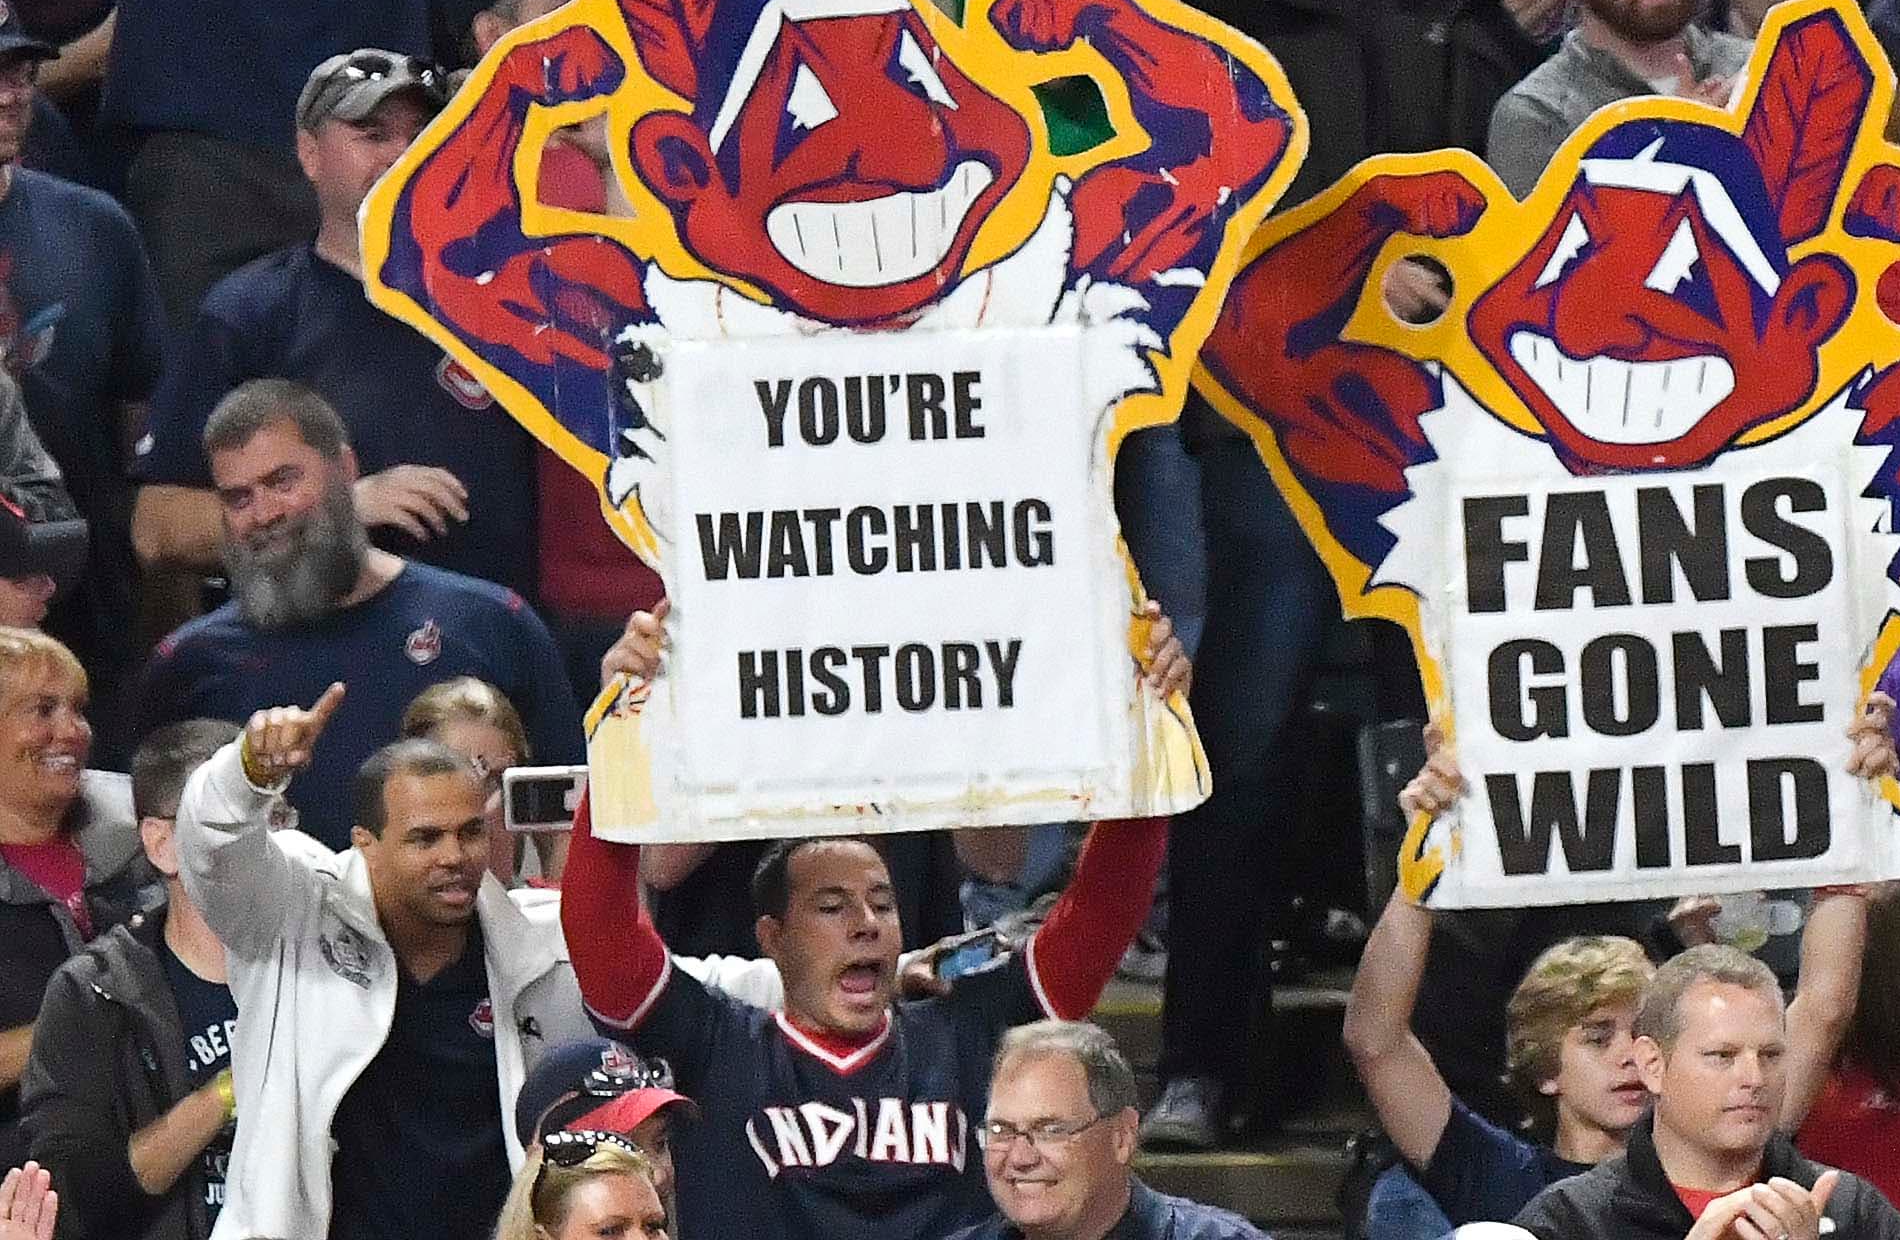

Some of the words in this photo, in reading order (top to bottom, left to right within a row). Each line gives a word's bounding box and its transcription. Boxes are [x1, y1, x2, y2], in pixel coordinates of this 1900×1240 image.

[754, 371, 986, 448] YOU'RE
[695, 498, 1055, 581] WATCHING
[1462, 476, 1834, 615] FANS
[737, 639, 1022, 719] HISTORY
[1487, 623, 1825, 743] GONE
[1484, 757, 1832, 877] WILD
